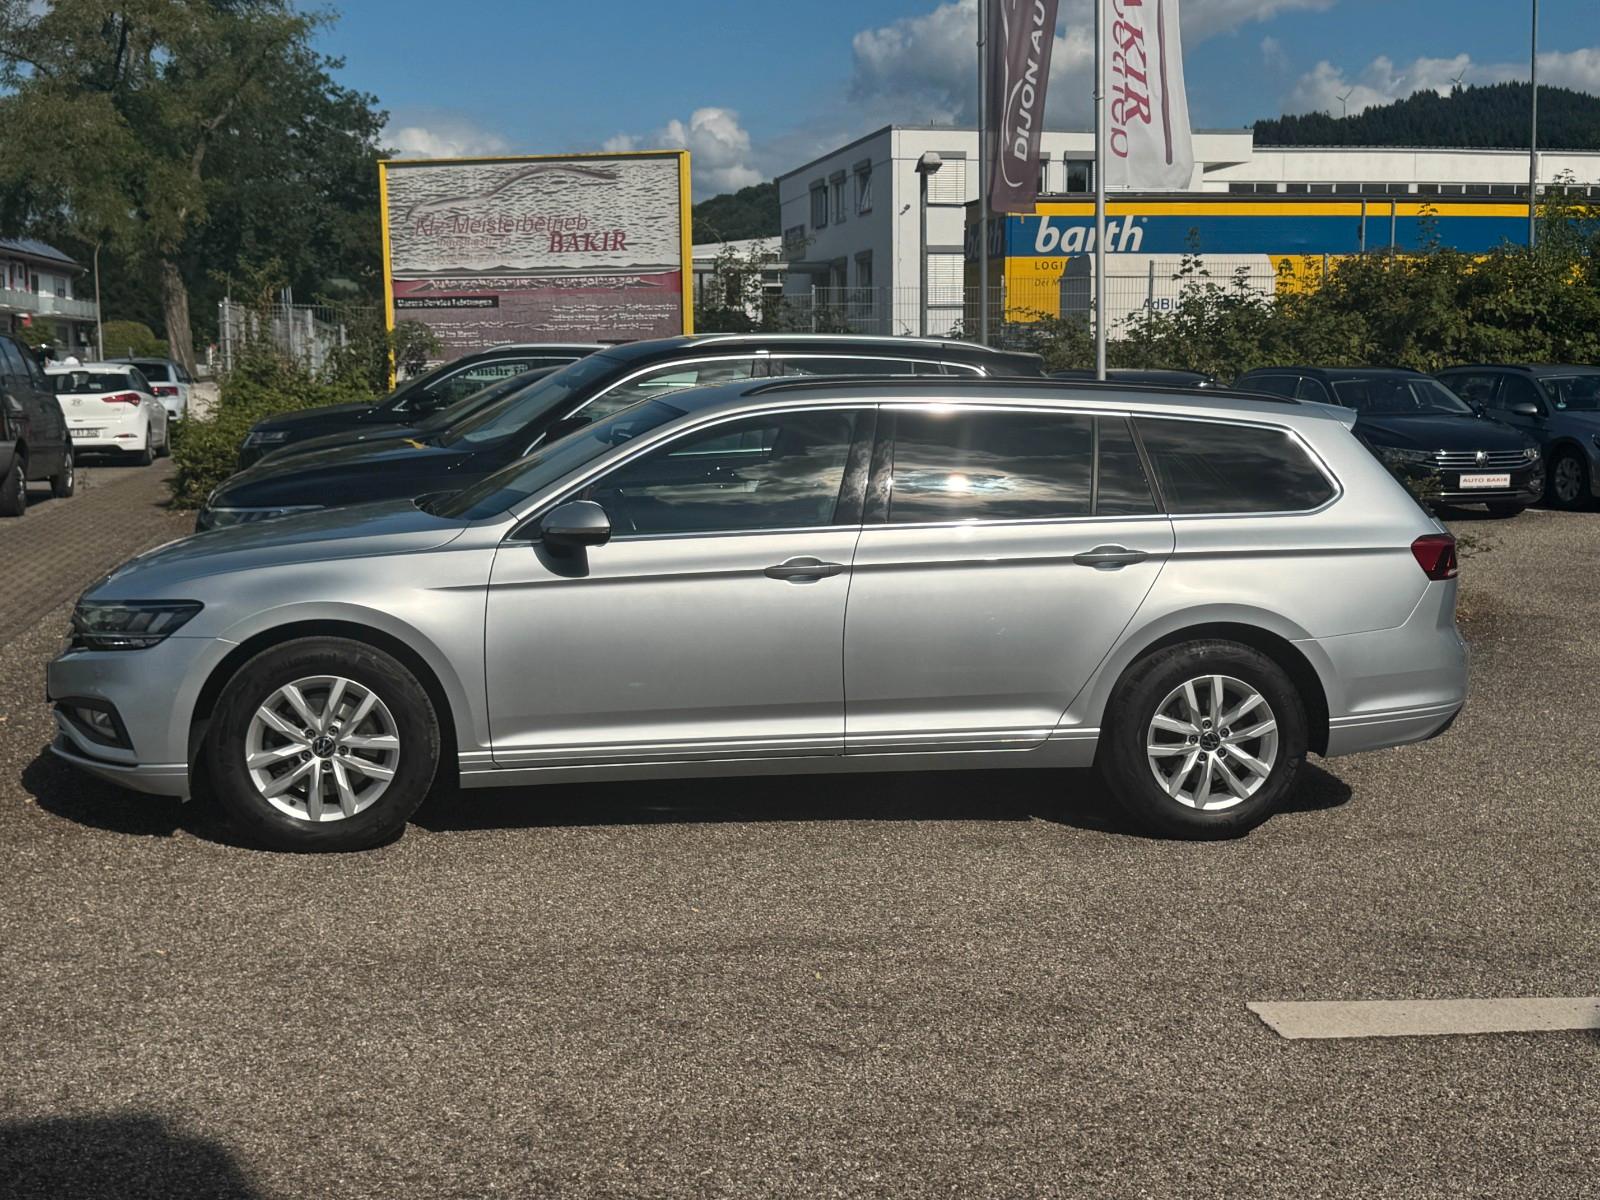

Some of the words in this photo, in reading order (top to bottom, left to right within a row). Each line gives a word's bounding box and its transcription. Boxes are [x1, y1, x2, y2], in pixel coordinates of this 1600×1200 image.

[1123, 0, 1151, 124] KIR
[1013, 58, 1039, 162] DIJON
[548, 229, 628, 253] BAKIR
[1034, 261, 1063, 271] LOGI
[1142, 298, 1184, 310] AdBlu
